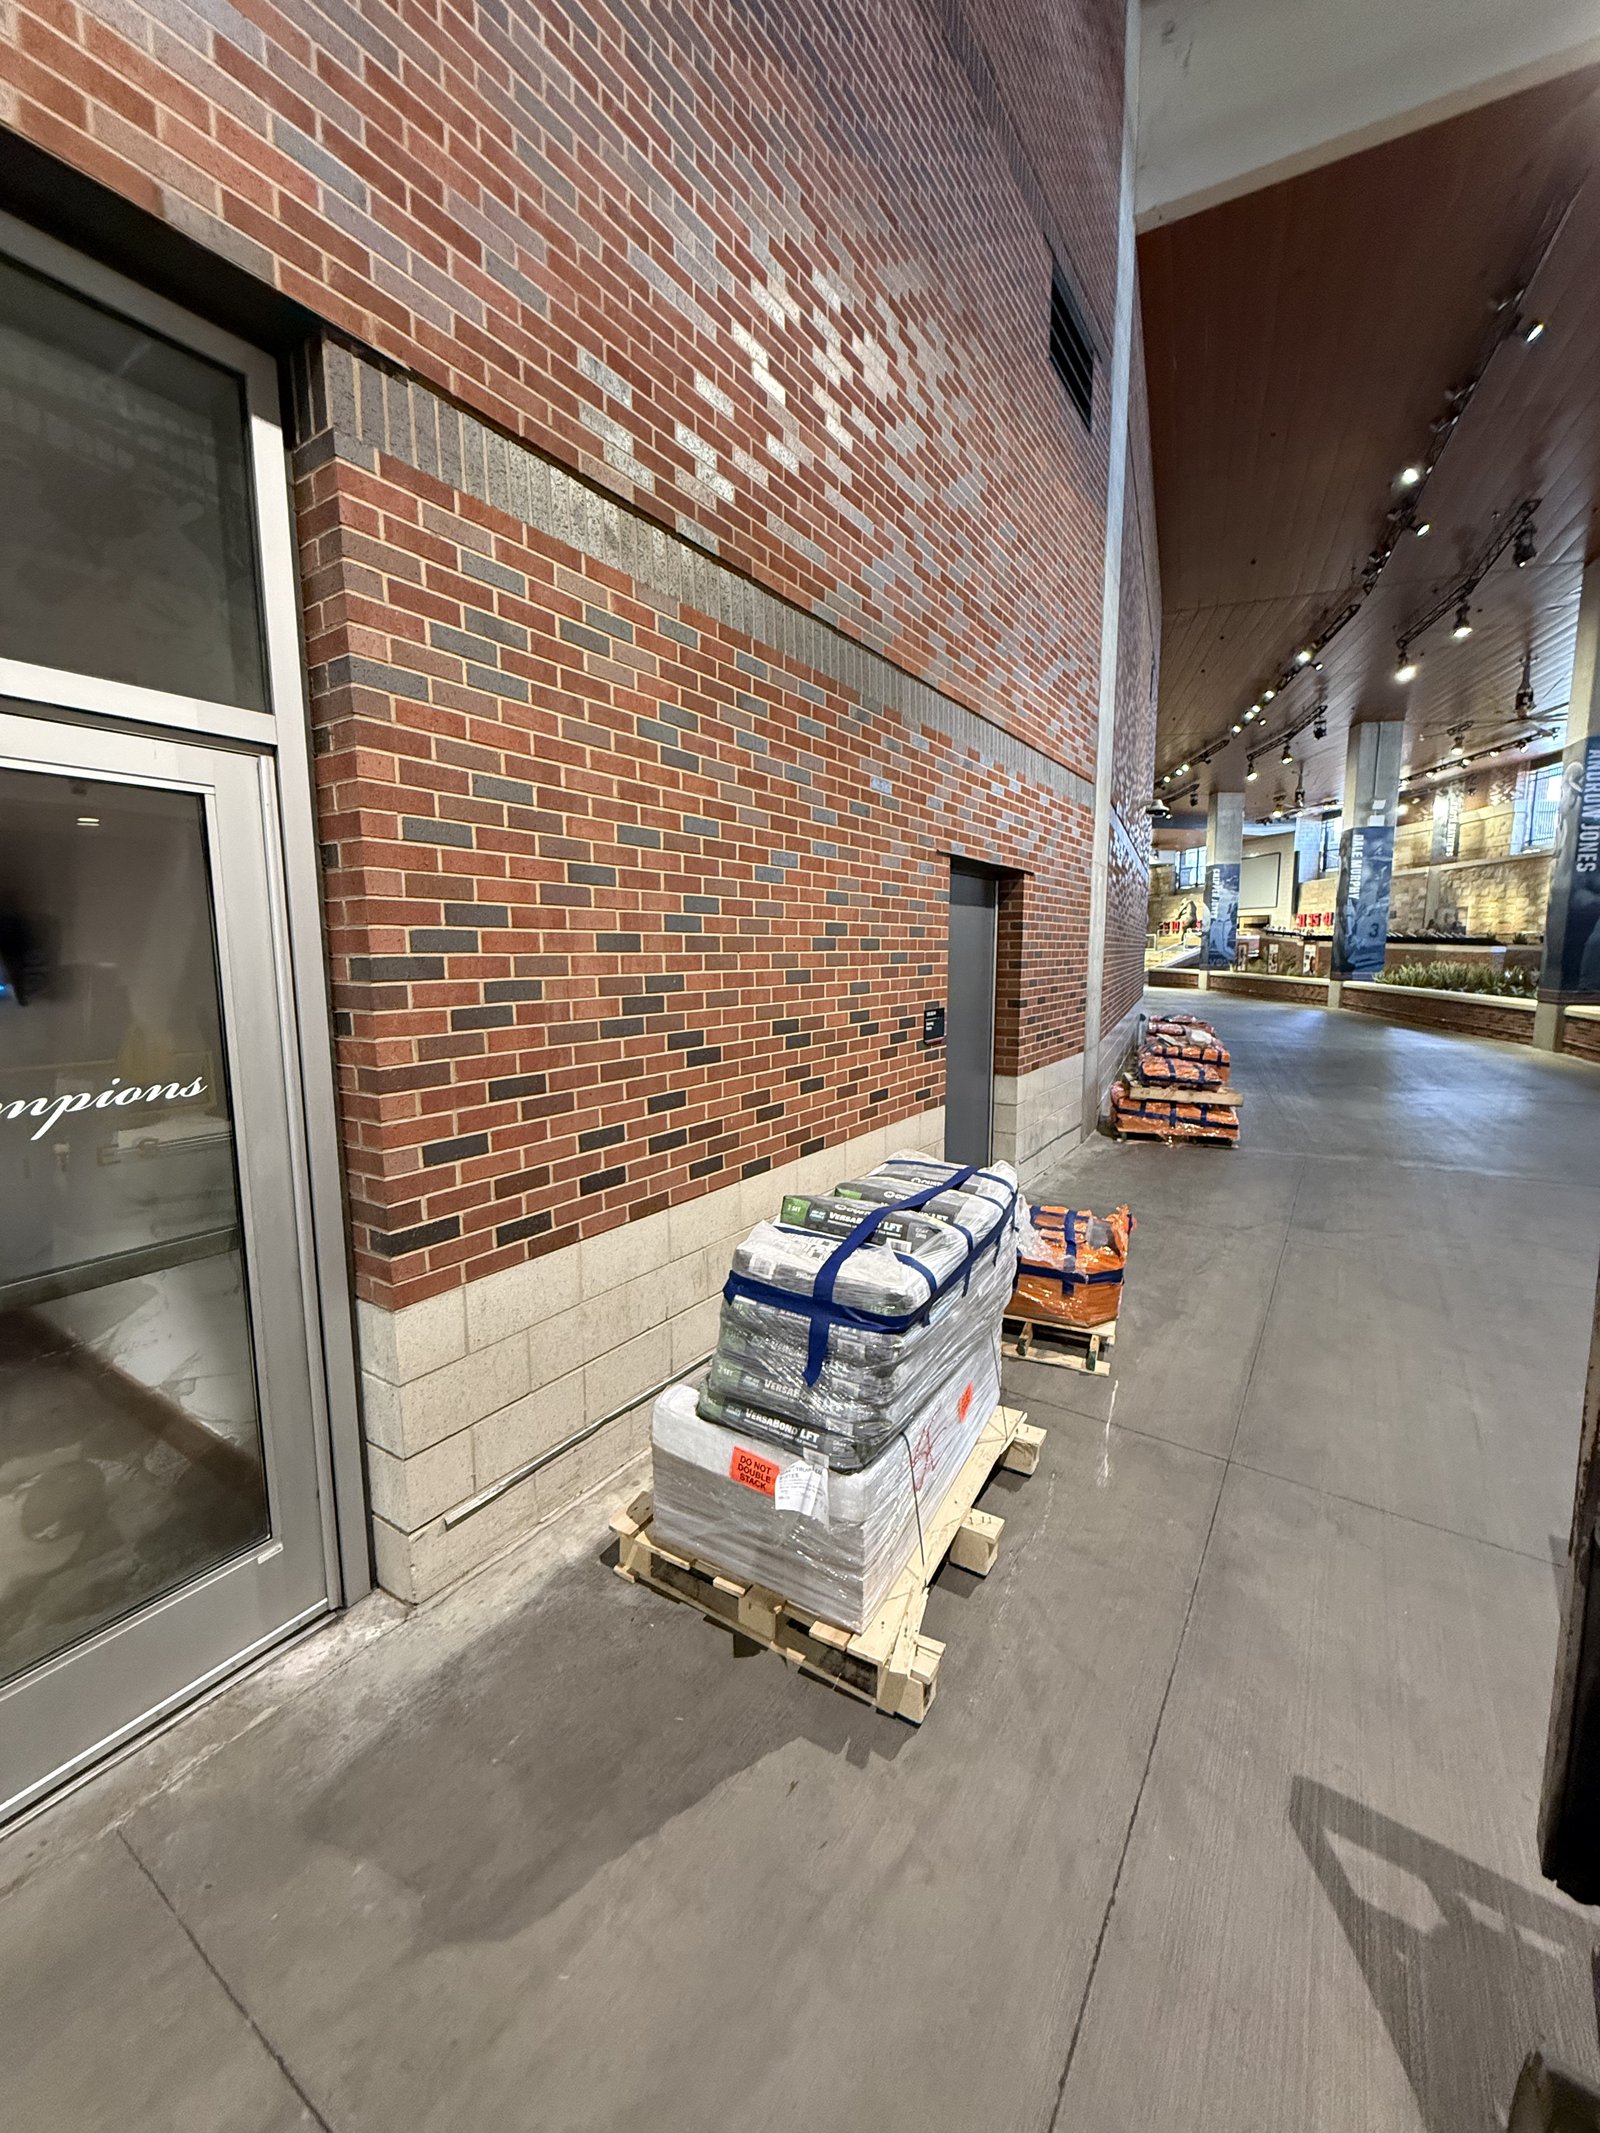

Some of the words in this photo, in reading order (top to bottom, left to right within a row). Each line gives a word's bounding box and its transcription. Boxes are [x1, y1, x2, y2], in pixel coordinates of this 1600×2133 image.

[1351, 834, 1364, 858] DALE
[1576, 823, 1600, 873] JONES
[1348, 859, 1363, 900] MURPHY
[885, 1221, 902, 1233] LFT
[745, 1407, 798, 1436] VERSABOND
[800, 1428, 820, 1444] LFT
[737, 1463, 771, 1484] DOUBLE
[740, 1455, 752, 1464] DO
[754, 1461, 771, 1475] NOT
[740, 1473, 767, 1491] STACK
